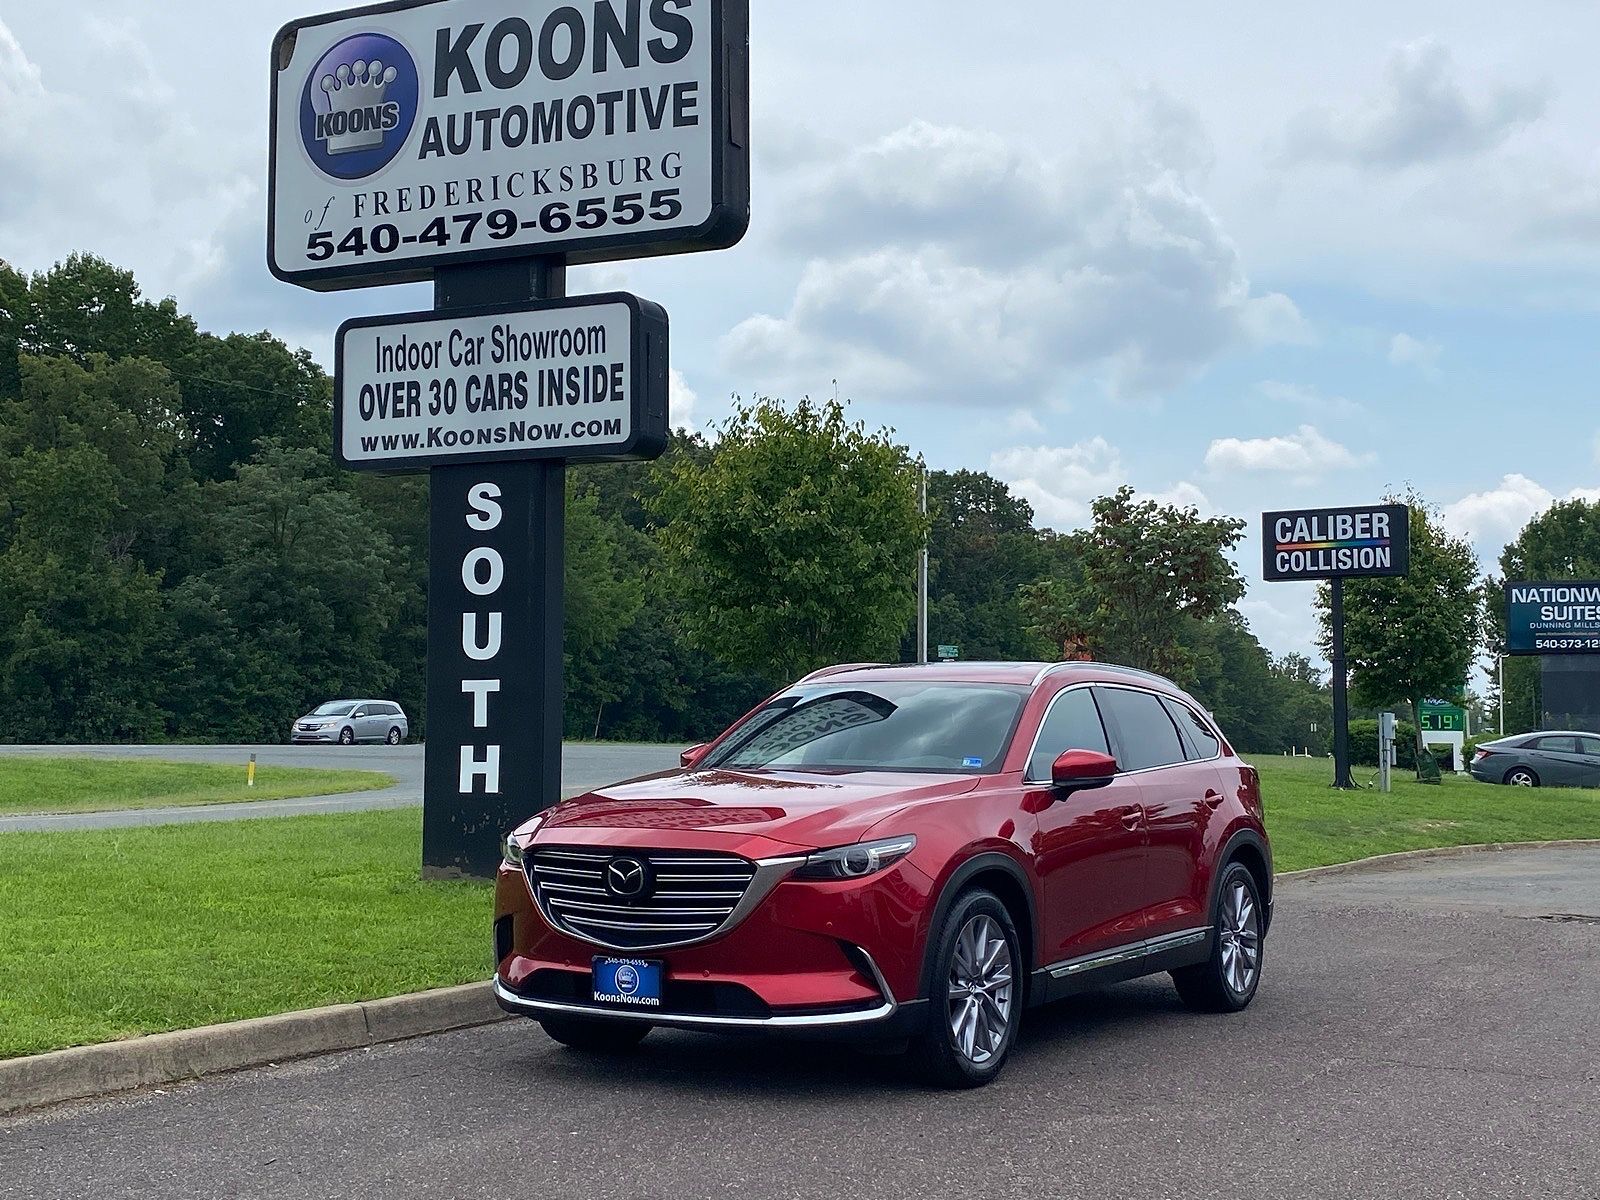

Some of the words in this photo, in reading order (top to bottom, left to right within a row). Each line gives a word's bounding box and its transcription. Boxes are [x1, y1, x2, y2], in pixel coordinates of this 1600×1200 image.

[433, 0, 693, 99] KOONS
[317, 103, 398, 138] KOONS
[418, 81, 699, 159] AUTOMOTIVE
[304, 196, 335, 230] of
[353, 152, 682, 218] FREDERICKSBURG
[306, 188, 682, 261] 540-479-6555
[376, 334, 442, 373] Indoor
[449, 328, 484, 371] Car
[491, 324, 606, 365] Showroom
[359, 380, 421, 422] OVER
[428, 377, 456, 416] 30
[465, 371, 528, 413] CARS
[538, 362, 624, 407] INSIDE
[1275, 512, 1390, 543] CALIBER
[1275, 547, 1391, 573] COLLISION
[459, 482, 504, 793] SOUTH
[1535, 639, 1600, 649] 540-373-12
[593, 991, 660, 1006] KoonsNow.com
